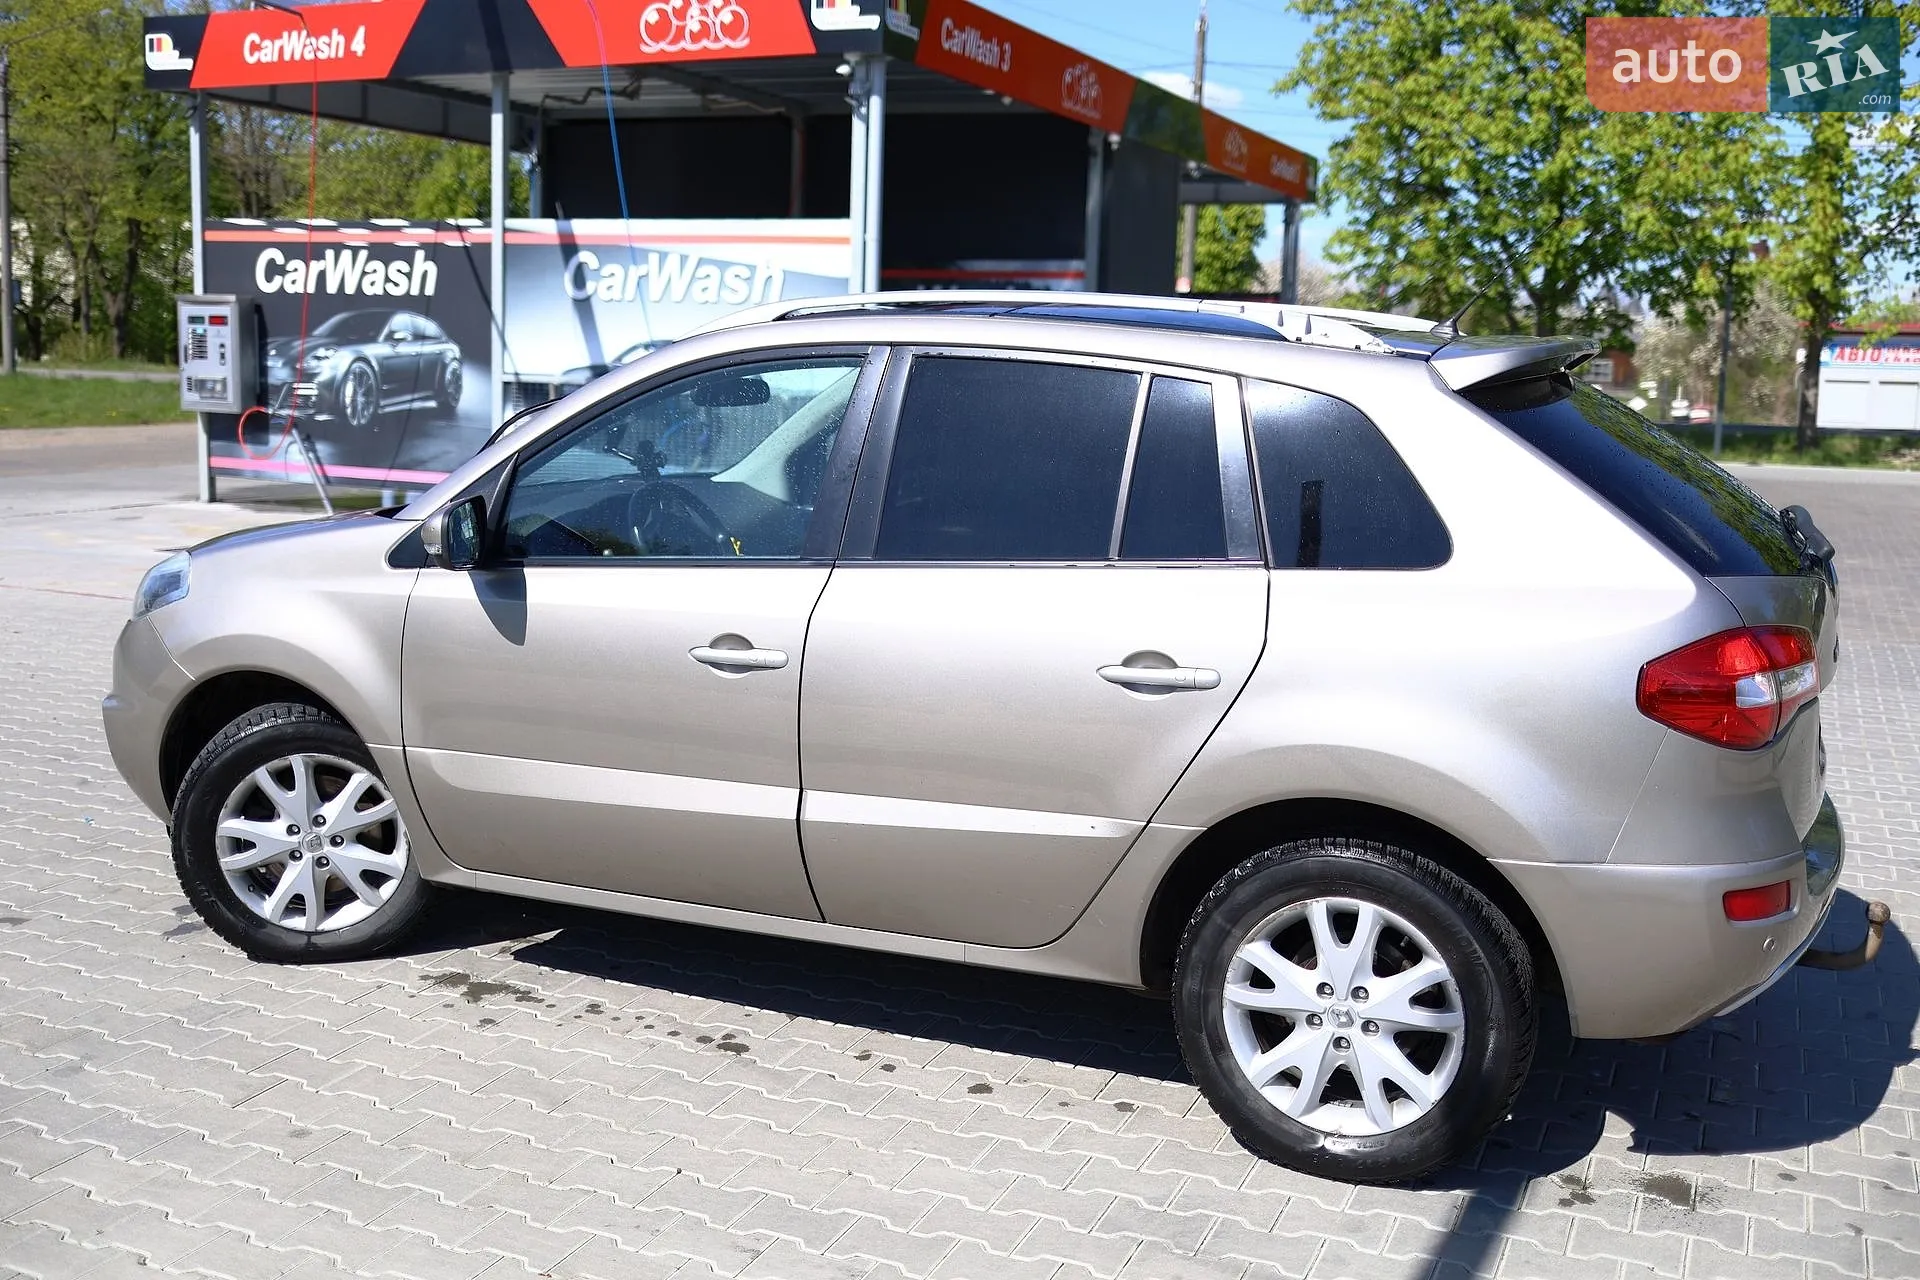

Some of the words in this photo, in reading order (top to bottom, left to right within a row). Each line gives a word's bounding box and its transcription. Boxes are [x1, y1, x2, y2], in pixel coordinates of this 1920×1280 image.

[243, 28, 346, 64] CarWash
[350, 25, 366, 57] 4
[940, 17, 1000, 68] CarWash
[1001, 41, 1012, 73] 3
[255, 247, 438, 297] CarWash
[564, 250, 785, 306] CarWash
